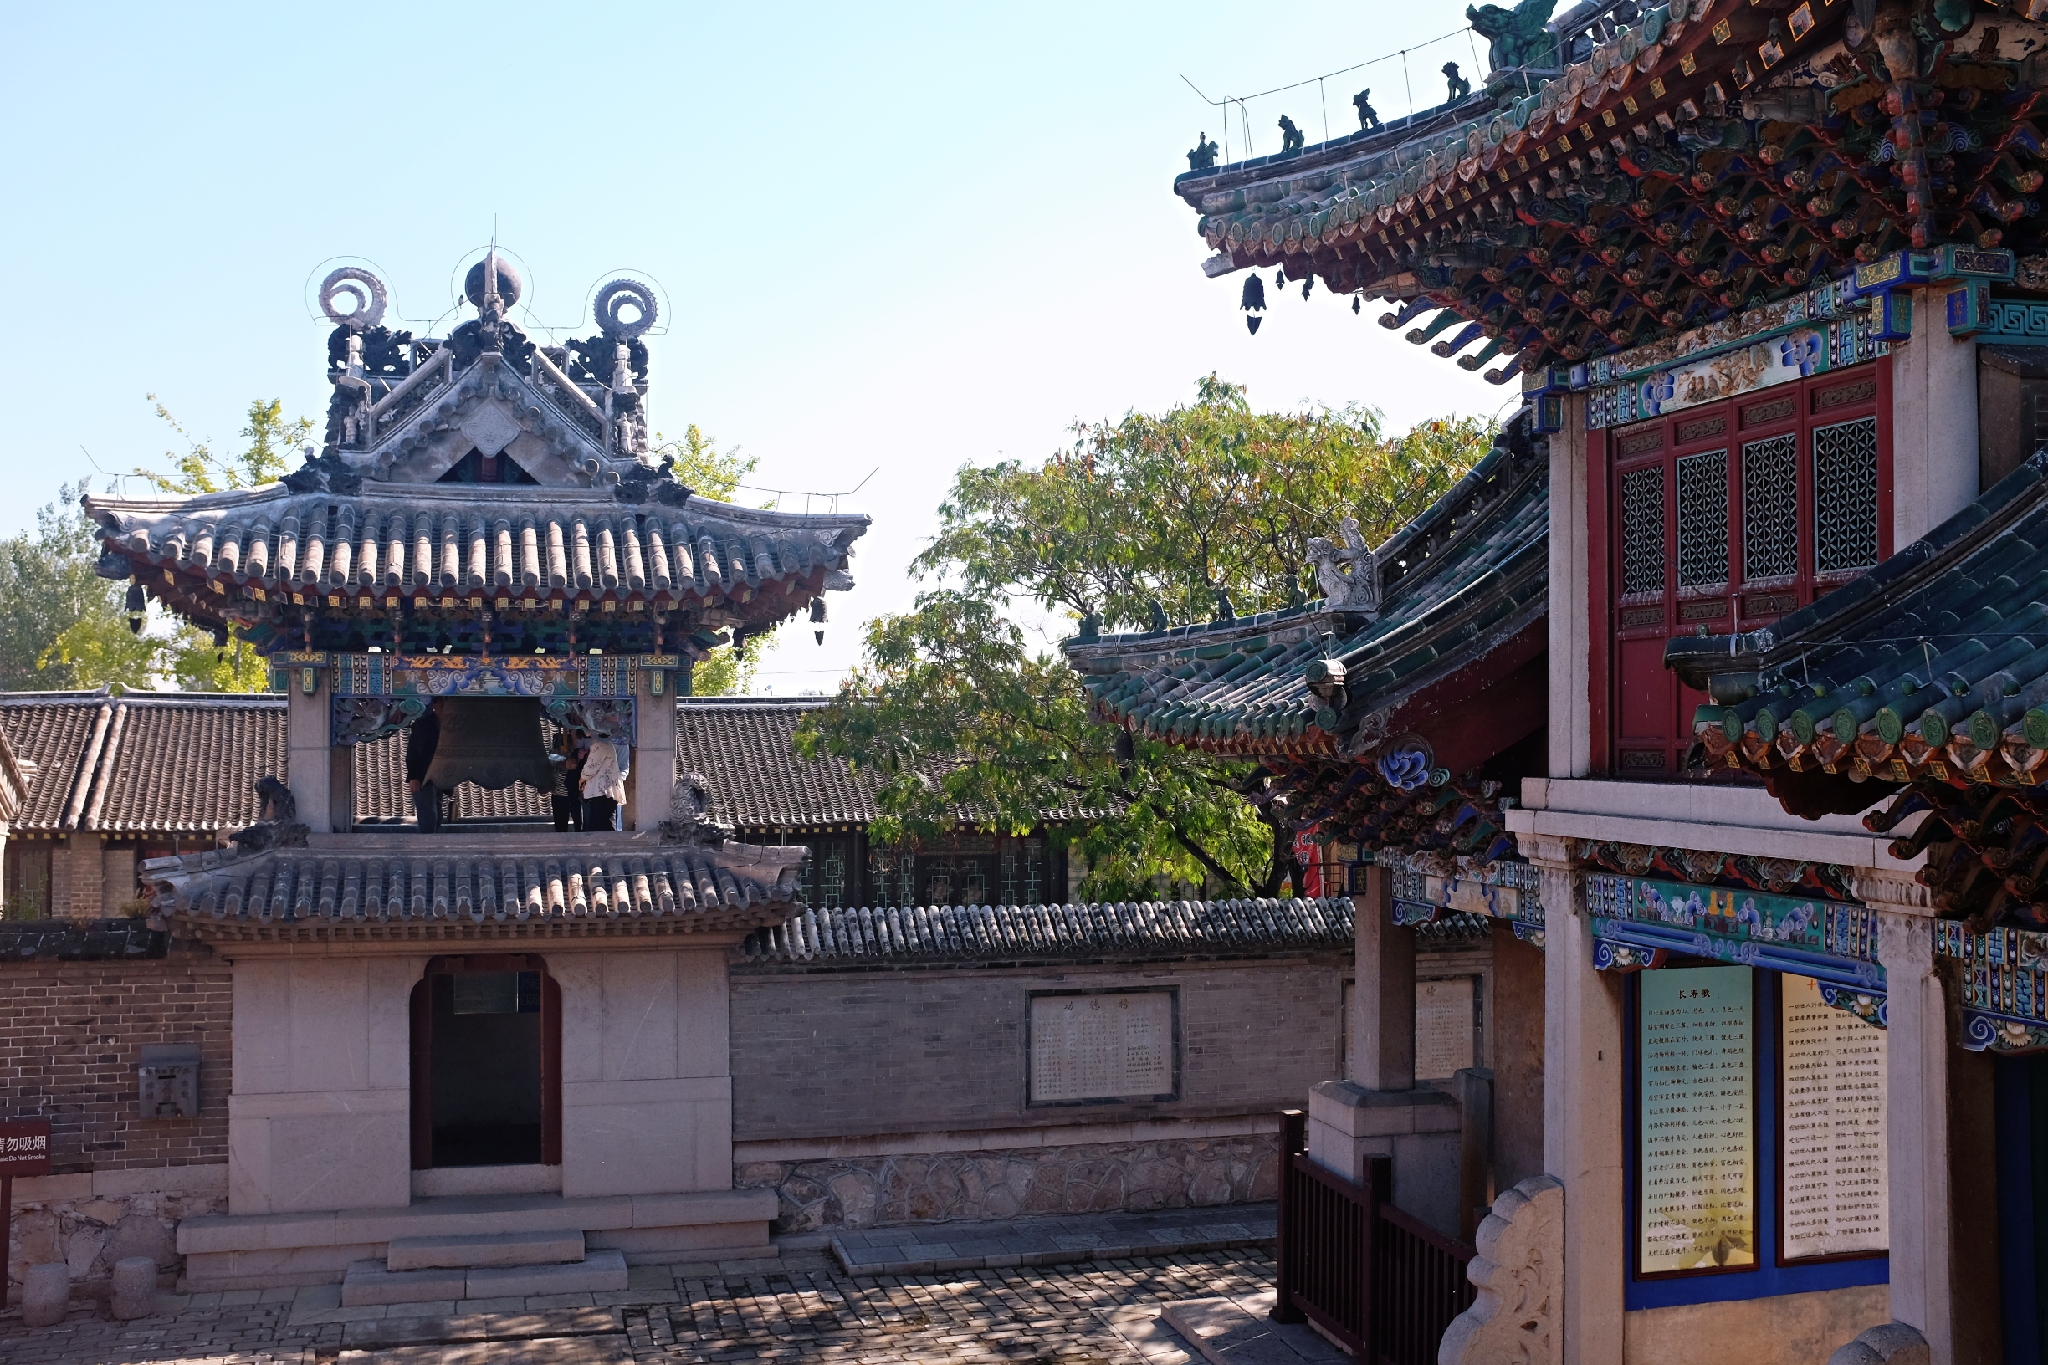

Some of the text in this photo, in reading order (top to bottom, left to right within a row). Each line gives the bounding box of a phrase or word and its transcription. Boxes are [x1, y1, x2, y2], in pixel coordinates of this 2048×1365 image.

[1677, 988, 1711, 999] 长寿歌
[28, 1153, 46, 1161] Smoke
